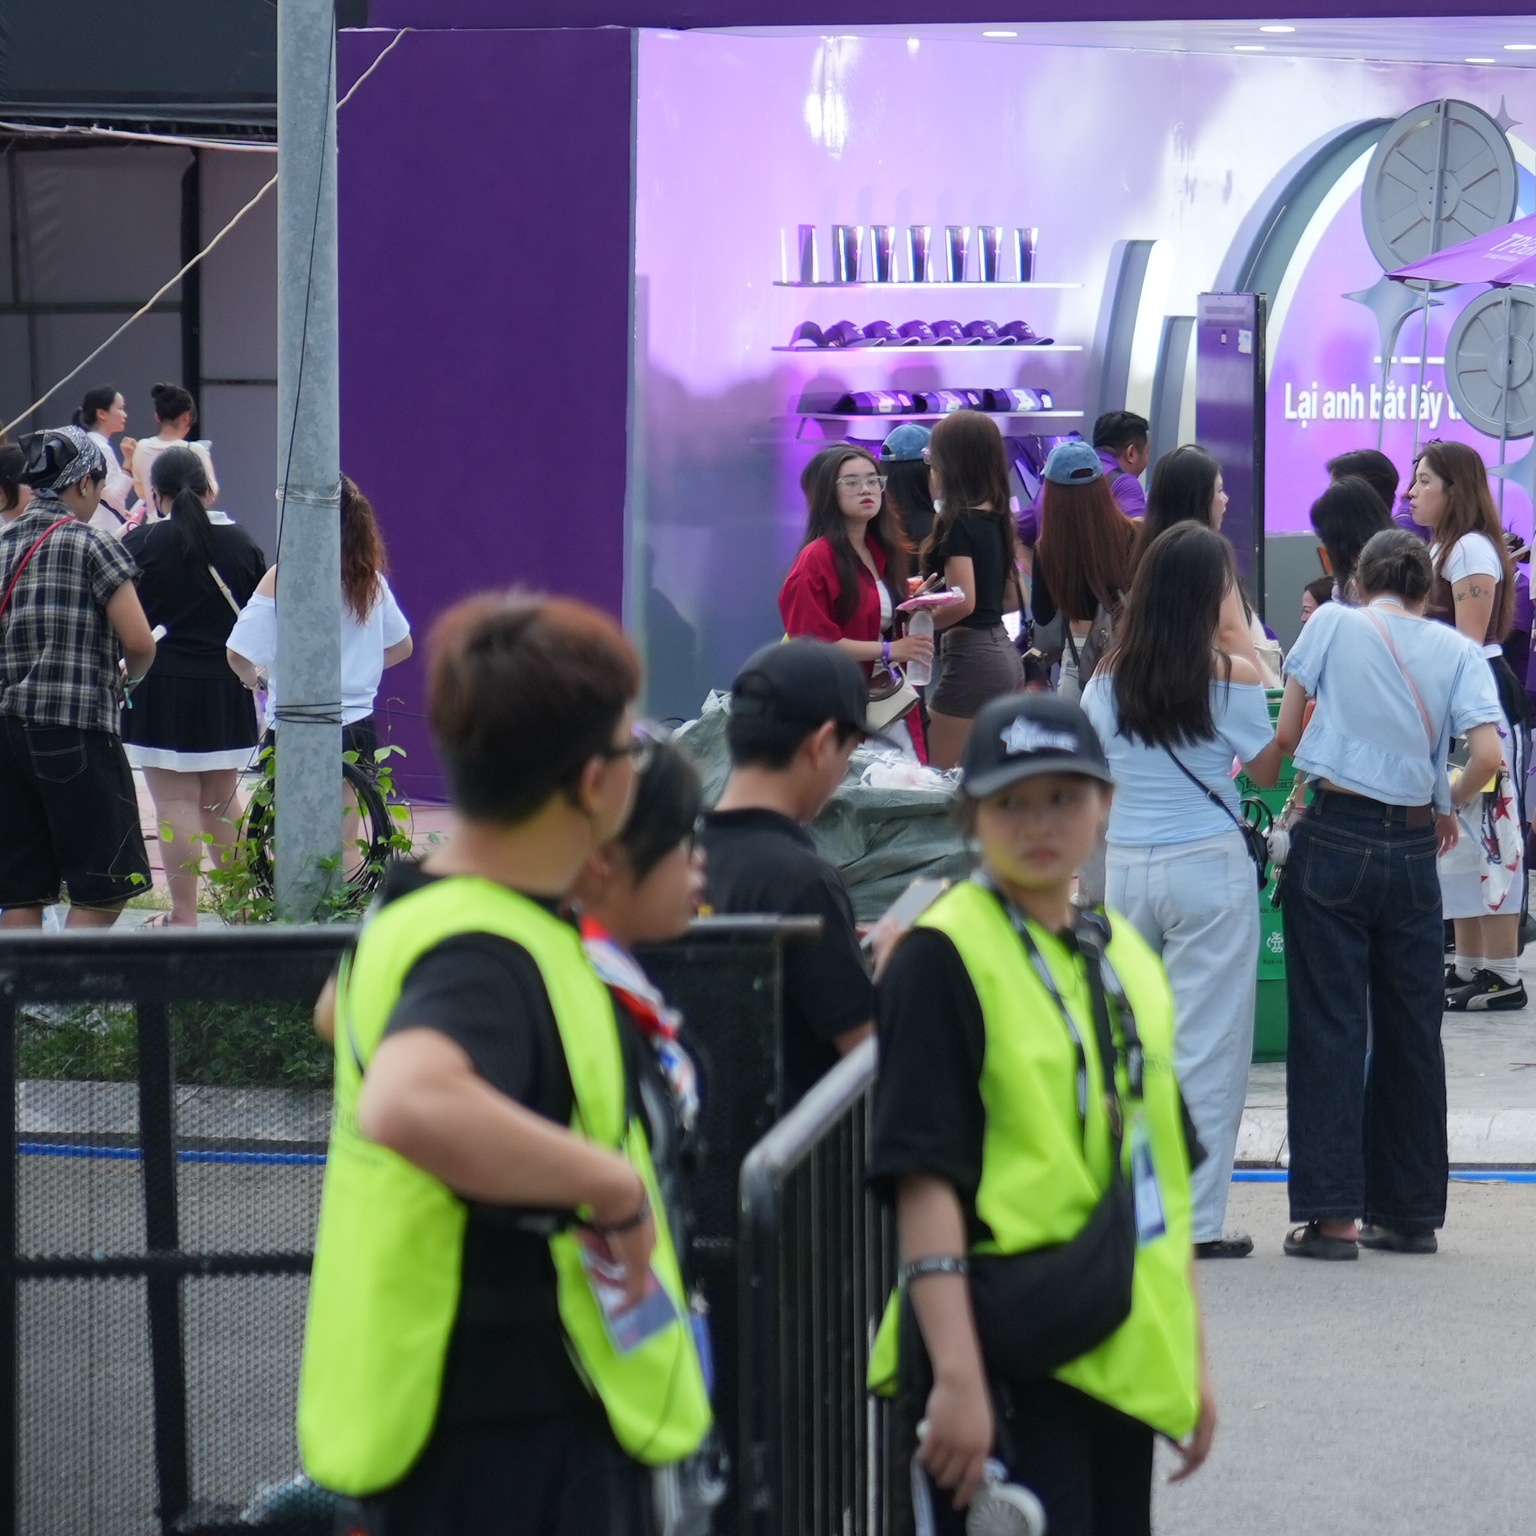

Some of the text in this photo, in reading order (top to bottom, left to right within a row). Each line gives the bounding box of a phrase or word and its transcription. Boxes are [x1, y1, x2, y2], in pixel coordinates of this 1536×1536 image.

[1284, 381, 1318, 430] Lại
[1322, 382, 1365, 421] anh
[1370, 379, 1406, 421] bắt
[1411, 379, 1443, 430] lấy
